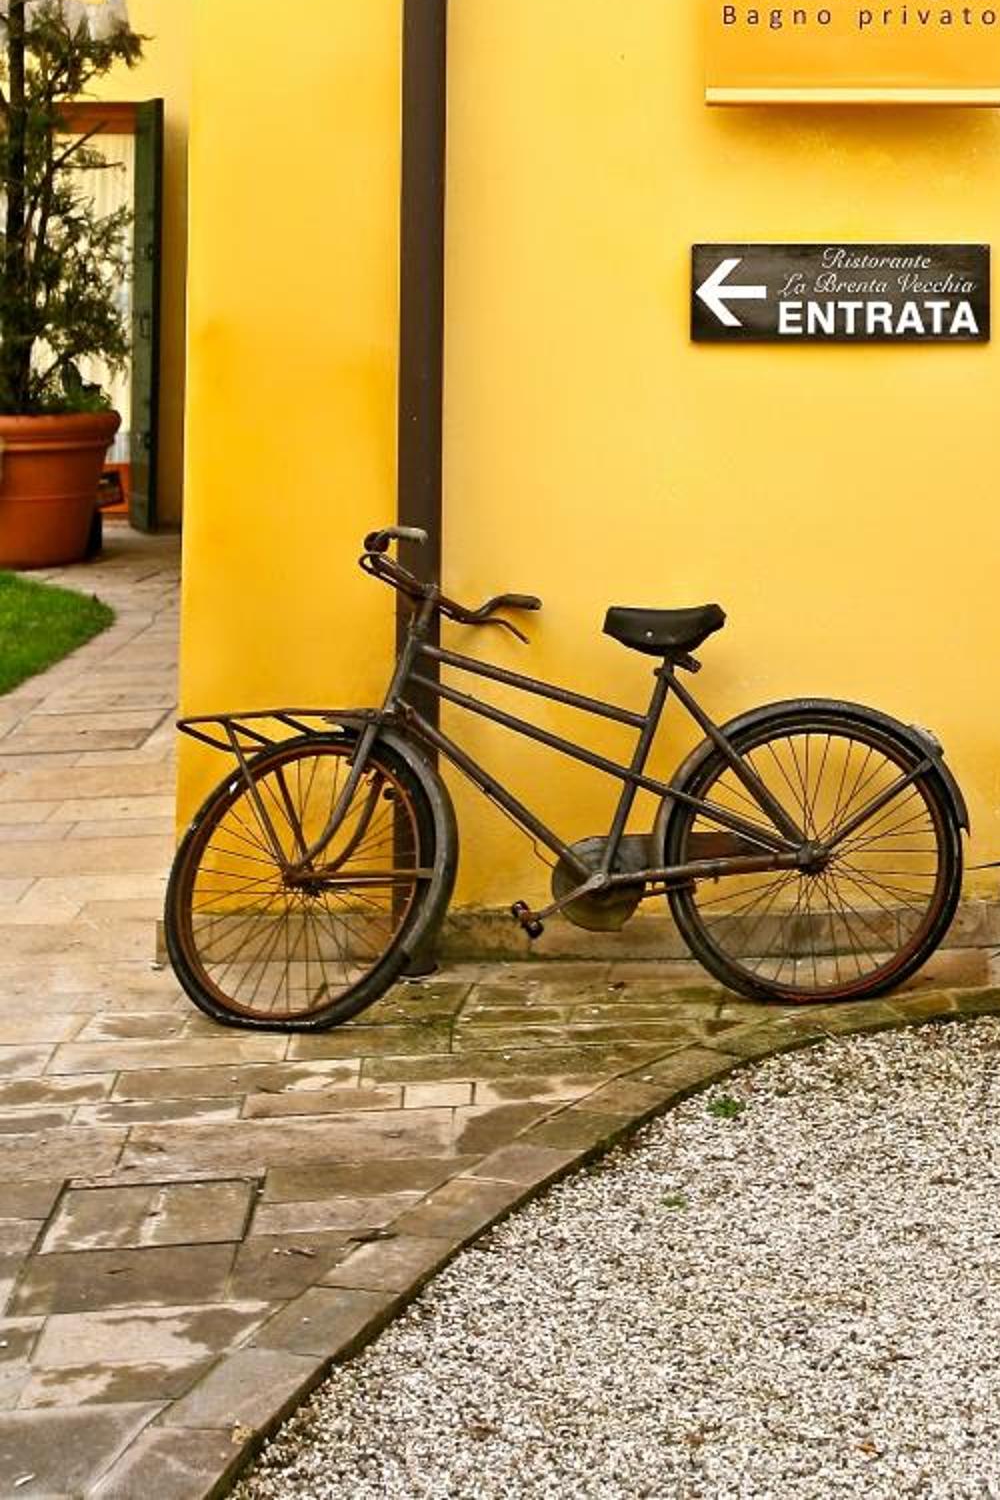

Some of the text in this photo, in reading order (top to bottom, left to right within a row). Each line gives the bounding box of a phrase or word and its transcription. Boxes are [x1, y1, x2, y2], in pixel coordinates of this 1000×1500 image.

[723, 5, 997, 30] Bagno privato
[822, 247, 931, 269] Ristorante
[777, 273, 976, 297] La Brenta Vecchia
[779, 301, 979, 335] ENTRATA
